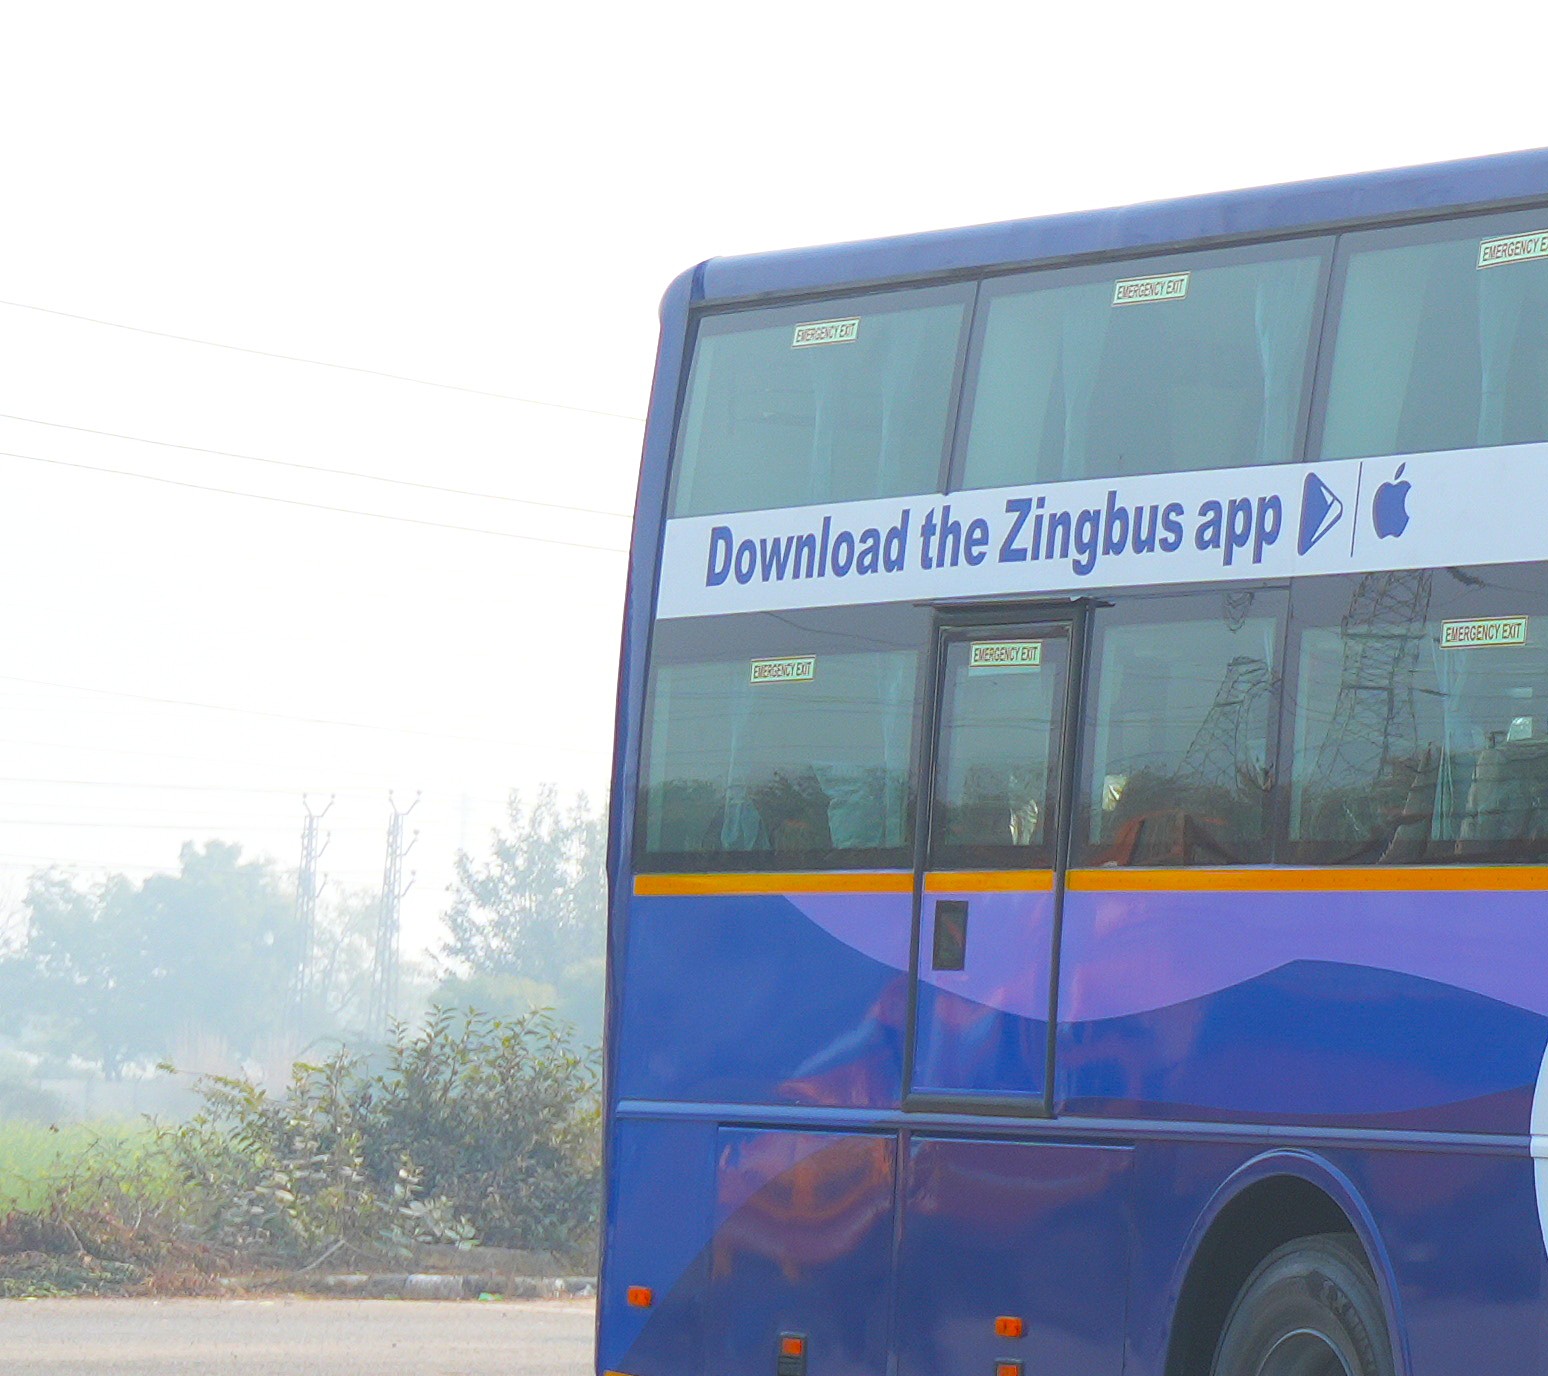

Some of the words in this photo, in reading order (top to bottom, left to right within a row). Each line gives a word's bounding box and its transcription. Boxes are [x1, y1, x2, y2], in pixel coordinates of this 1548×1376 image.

[1483, 238, 1540, 262] EMERGENCY
[1116, 281, 1166, 300] EMERGENCY
[1166, 279, 1185, 293] EXIT
[795, 325, 838, 343] EMERGENCY
[840, 323, 855, 338] EXIT
[705, 507, 911, 587] Download
[920, 504, 989, 570] the
[999, 488, 1184, 577] Zingbus
[1195, 493, 1283, 566] app
[1446, 625, 1500, 642] EMERGENCY
[1501, 623, 1522, 639] EXIT
[974, 646, 1020, 662] EMERGENCY
[1021, 646, 1038, 661] EXIT
[753, 663, 795, 679] EMERGENCY
[796, 661, 811, 676] EXIT
